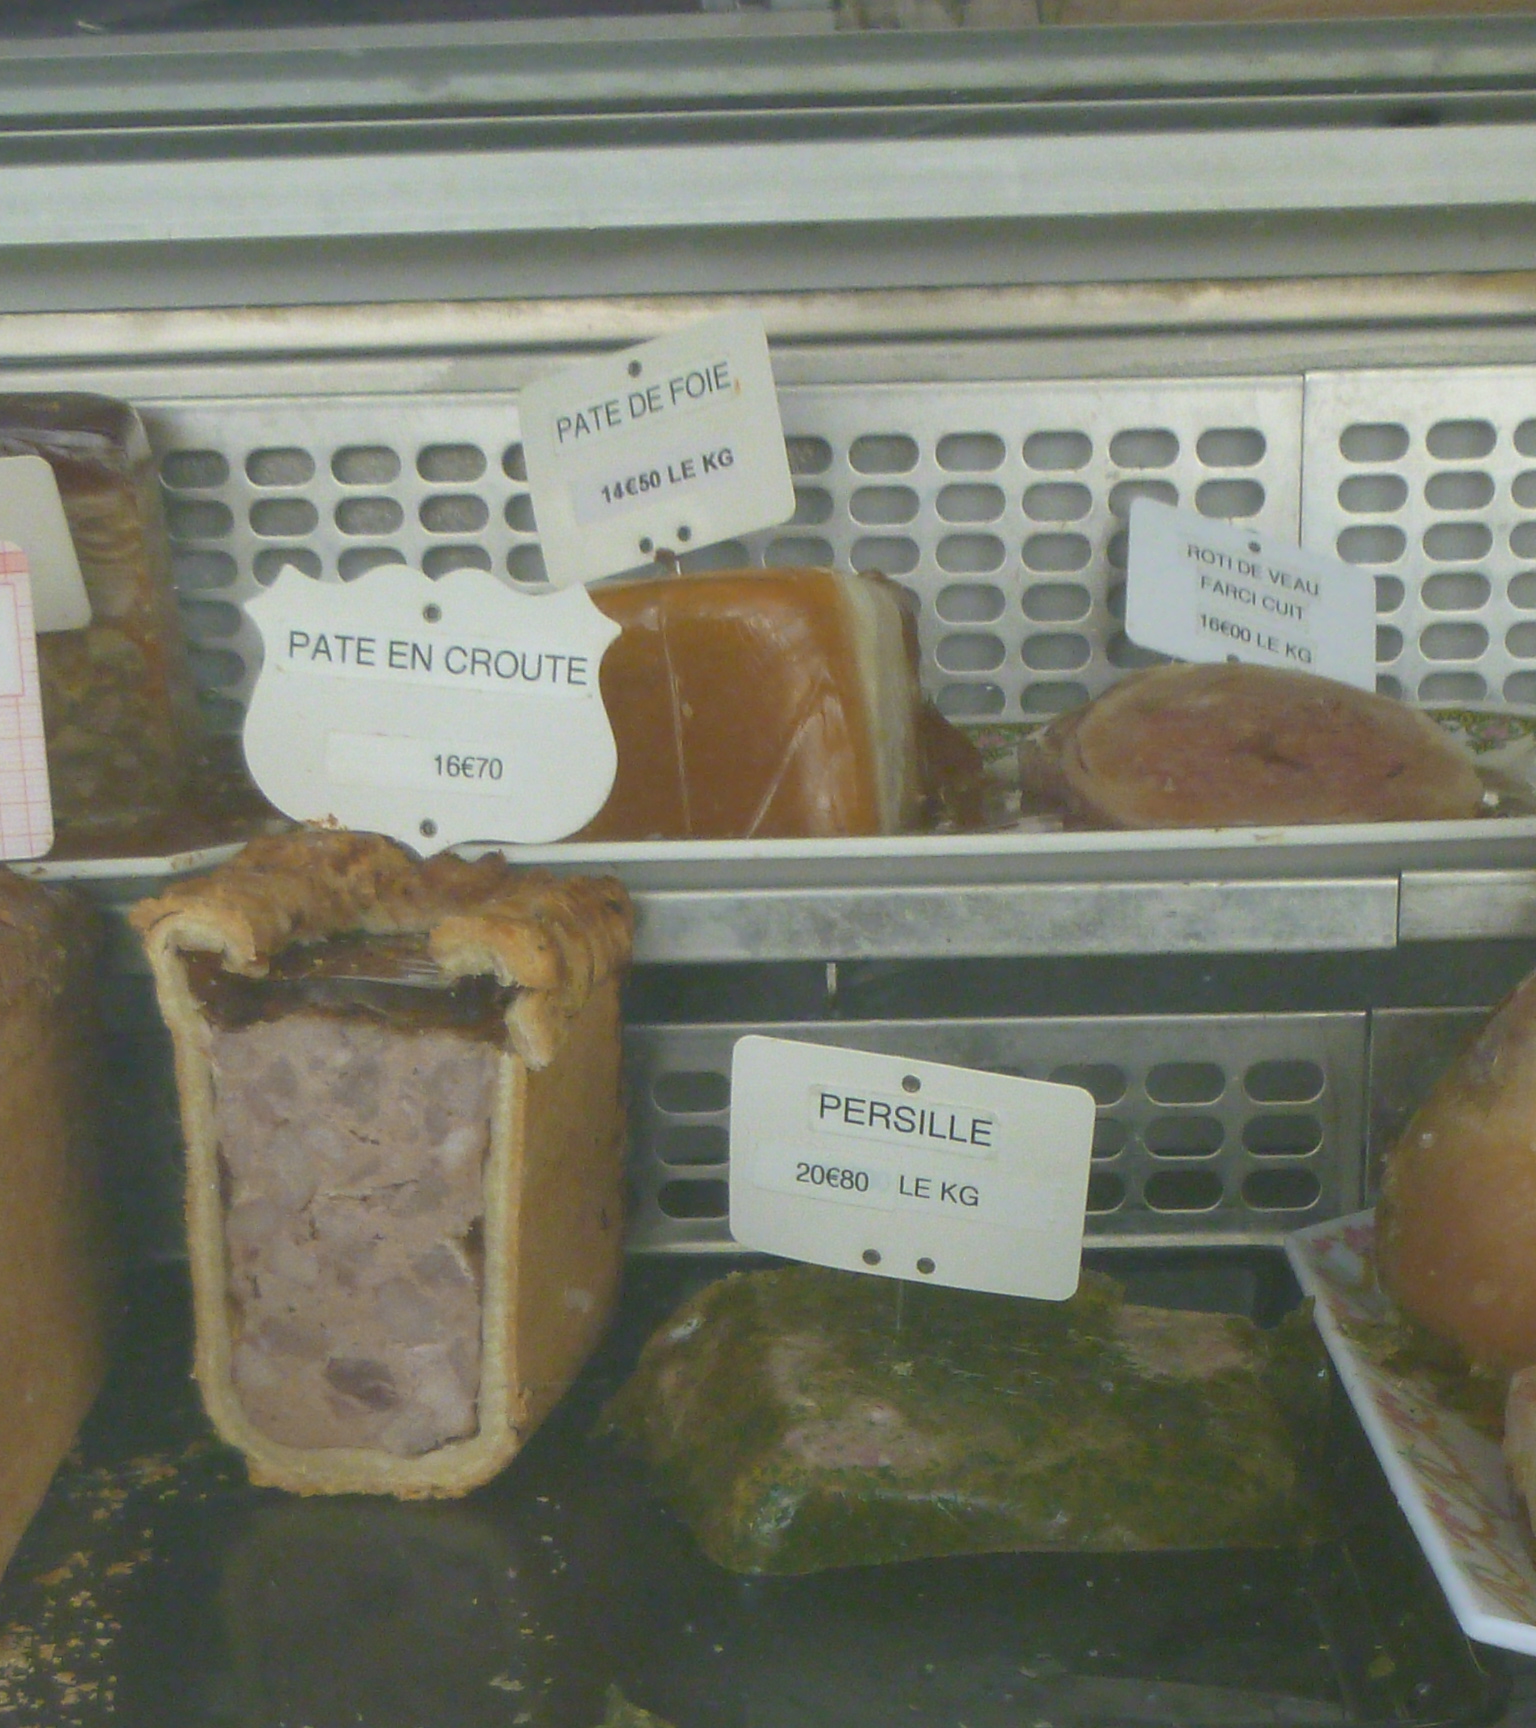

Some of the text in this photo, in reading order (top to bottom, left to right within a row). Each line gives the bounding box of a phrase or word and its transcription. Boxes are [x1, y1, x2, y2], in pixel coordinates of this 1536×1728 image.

[556, 362, 731, 443] PATE DE FOIE
[601, 448, 735, 504] 14€50 LE KG
[1187, 544, 1319, 596] ROTI DE VEAU
[1200, 575, 1304, 620] FARCI CUIT
[289, 630, 588, 686] PATE EN CROUTE
[1257, 633, 1279, 653] LE
[1285, 642, 1312, 664] KG
[433, 755, 503, 780] 16€70
[819, 1091, 993, 1148] PERSILLE
[796, 1162, 980, 1207] 20€80 LE KG
